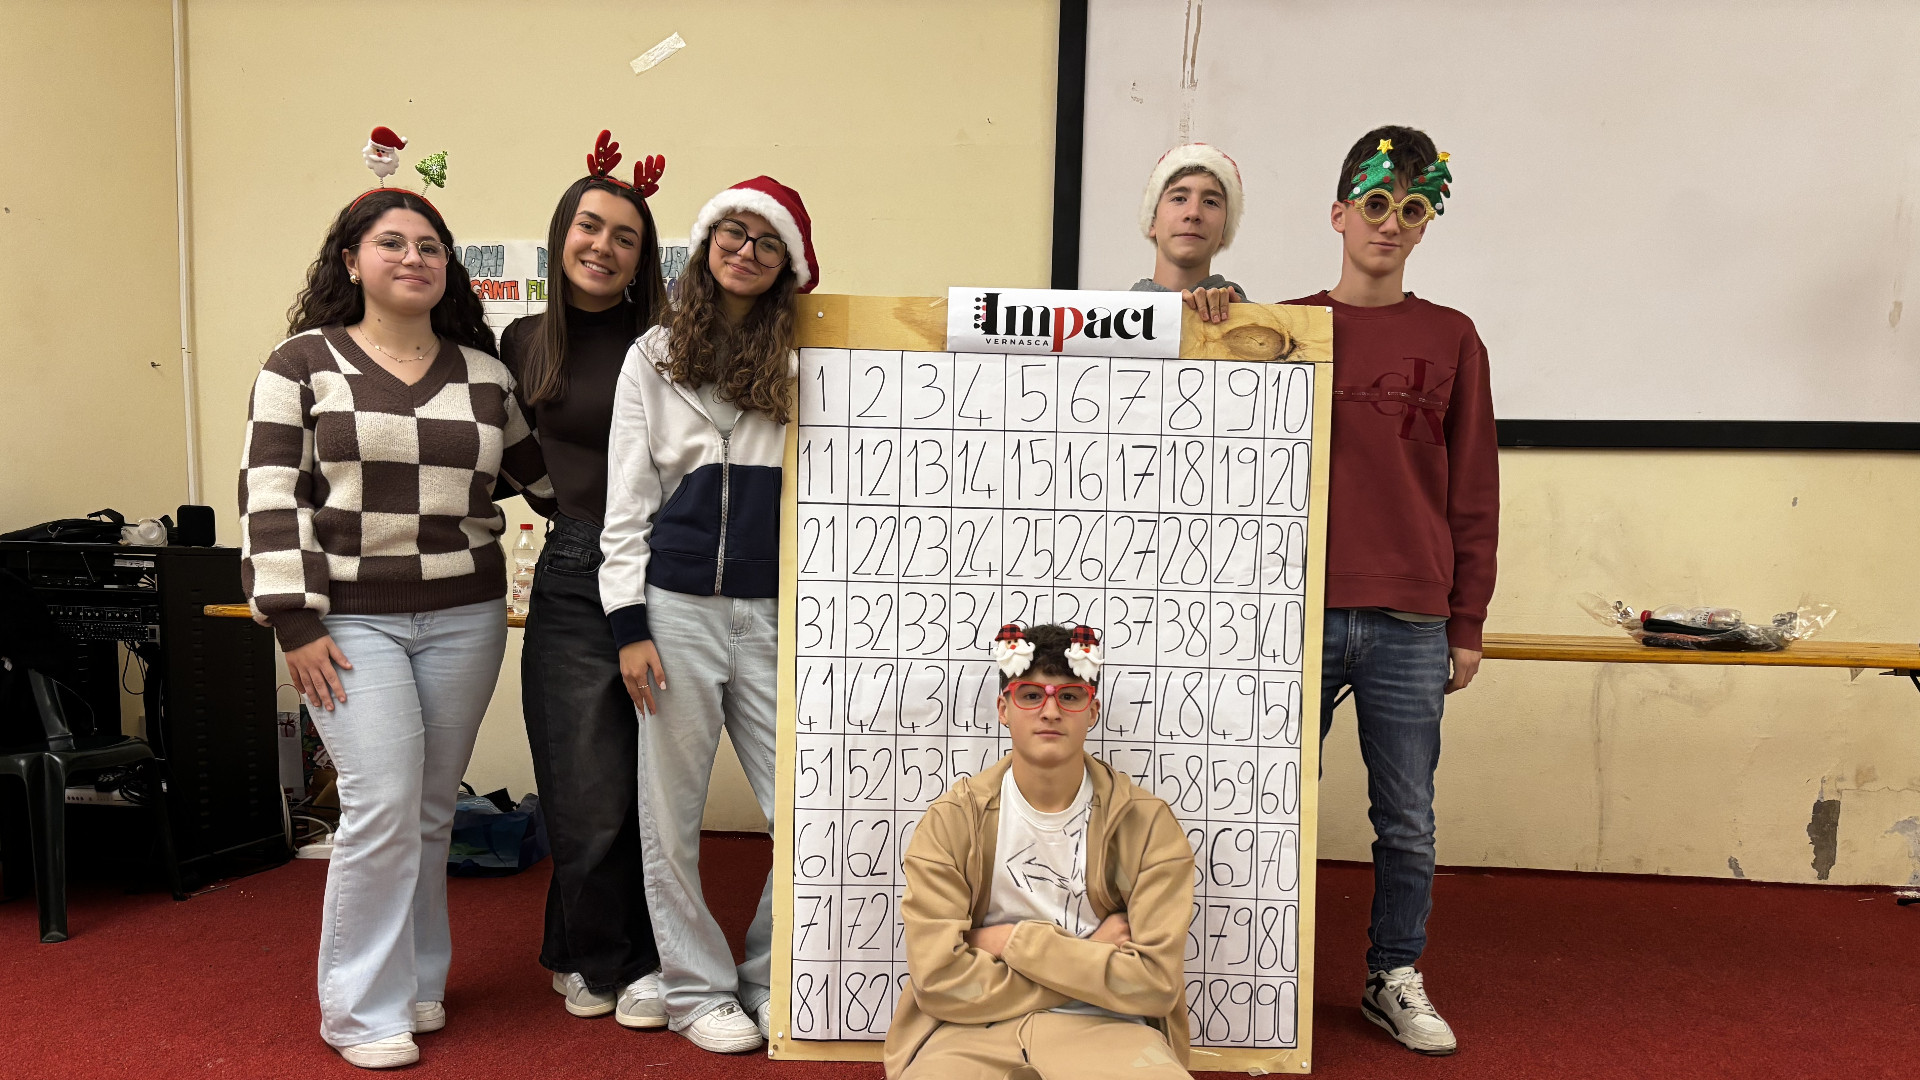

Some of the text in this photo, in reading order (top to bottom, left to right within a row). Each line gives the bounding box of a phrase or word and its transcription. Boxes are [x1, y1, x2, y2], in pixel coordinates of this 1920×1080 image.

[981, 292, 1157, 352] Impact
[985, 337, 1049, 347] VERNASCA
[817, 364, 1308, 433] 1 2 3 4 5 6 7 8 9 10
[803, 438, 1309, 511] 11 12 13 14 15 16 17 18 19 20
[801, 515, 1304, 590] 21 22 23 24 25 26 27 28 29 30
[801, 596, 835, 649] 31
[851, 594, 893, 650] 32
[905, 592, 948, 655] 33
[955, 592, 995, 656] 34
[1110, 596, 1154, 649] 37
[1164, 599, 1207, 657] 38
[1216, 601, 1258, 661] 39
[1260, 601, 1301, 665] 40
[798, 662, 1300, 745] 41 42 43 44 47 48 49 50
[800, 747, 832, 798] 51
[849, 748, 892, 800] 52
[901, 748, 944, 802] 53
[1160, 753, 1203, 812] 58
[1212, 760, 1255, 815] 59
[1261, 761, 1297, 815] 60
[798, 821, 835, 878] 61
[847, 820, 890, 877] 62
[1209, 828, 1255, 887] 69
[1260, 830, 1298, 891] 70
[798, 895, 832, 951] 71
[848, 893, 888, 949] 72
[1209, 905, 1252, 965] 79
[1258, 905, 1297, 972] 80
[797, 973, 829, 1033] 81
[845, 972, 889, 1034] 82
[1206, 979, 1253, 1042] 89
[1255, 981, 1296, 1043] 90
